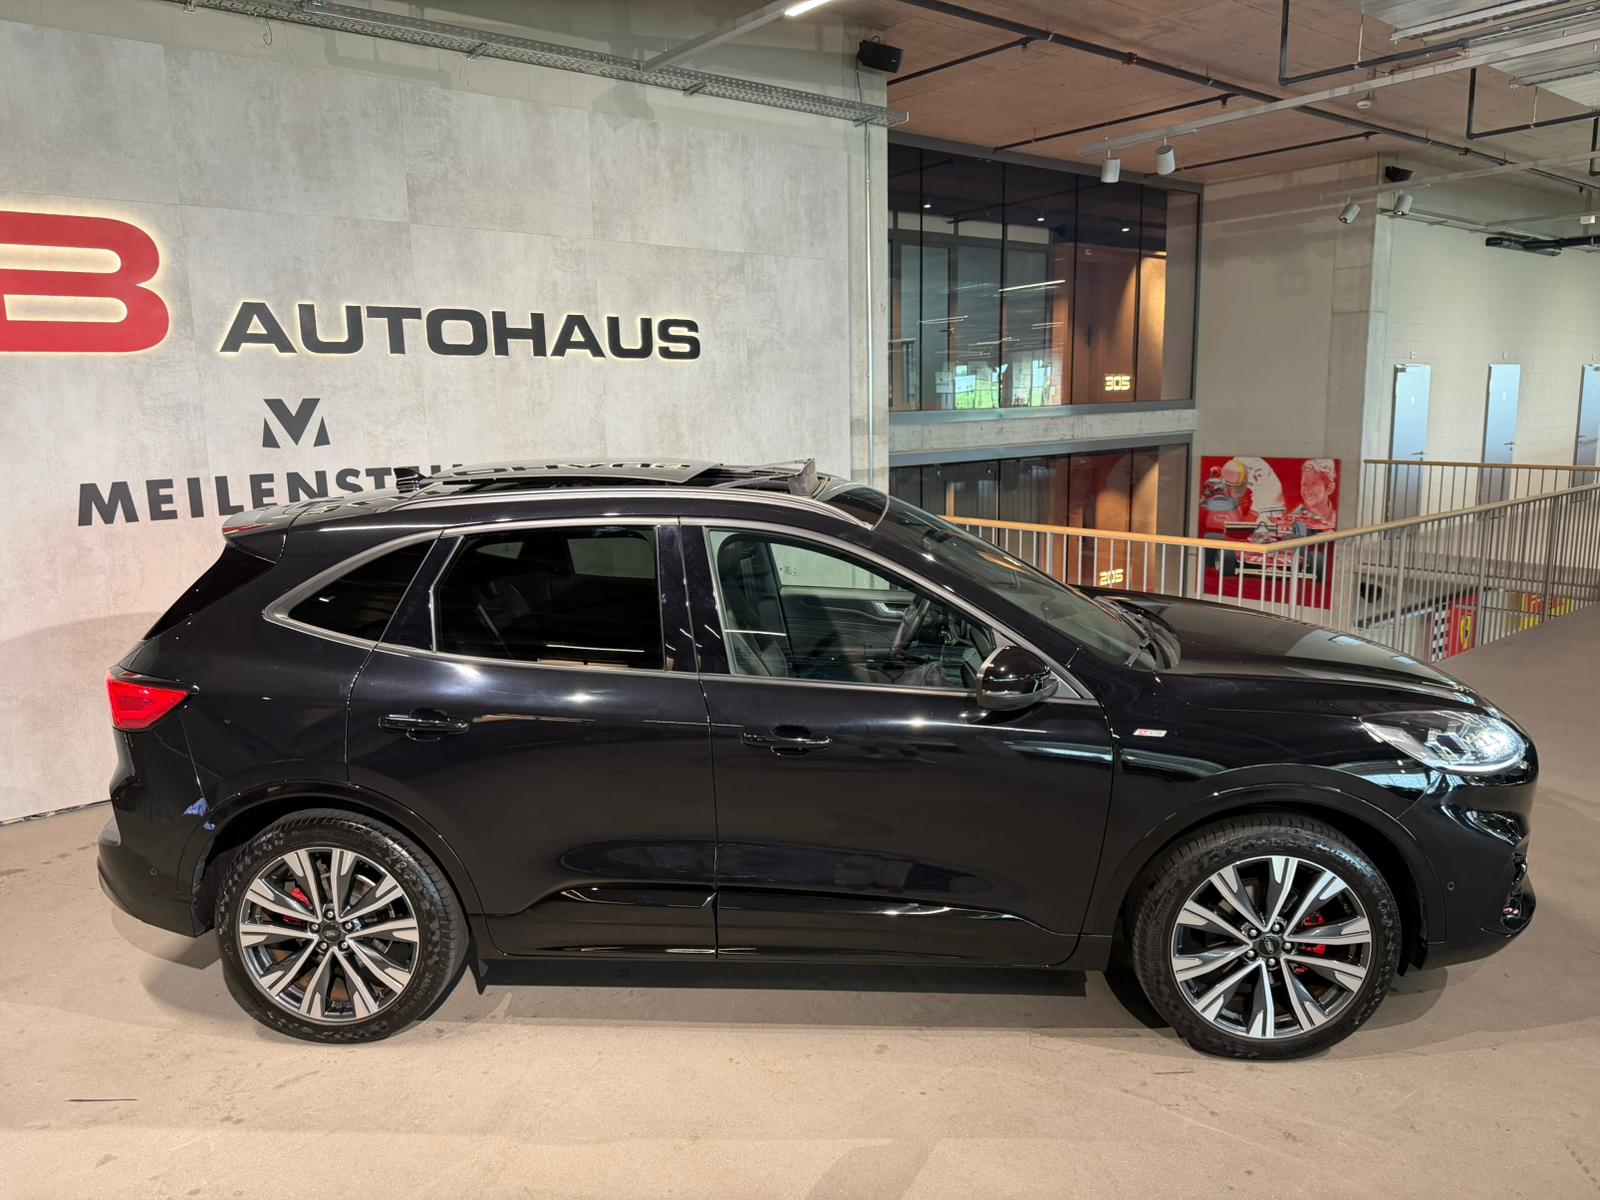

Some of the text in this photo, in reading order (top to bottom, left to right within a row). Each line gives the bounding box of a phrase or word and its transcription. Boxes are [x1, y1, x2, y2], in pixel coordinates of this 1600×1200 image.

[220, 301, 700, 360] AUTOHAUS
[1104, 375, 1131, 391] 305
[78, 464, 463, 527] MEILENST
[1099, 568, 1124, 586] 205
